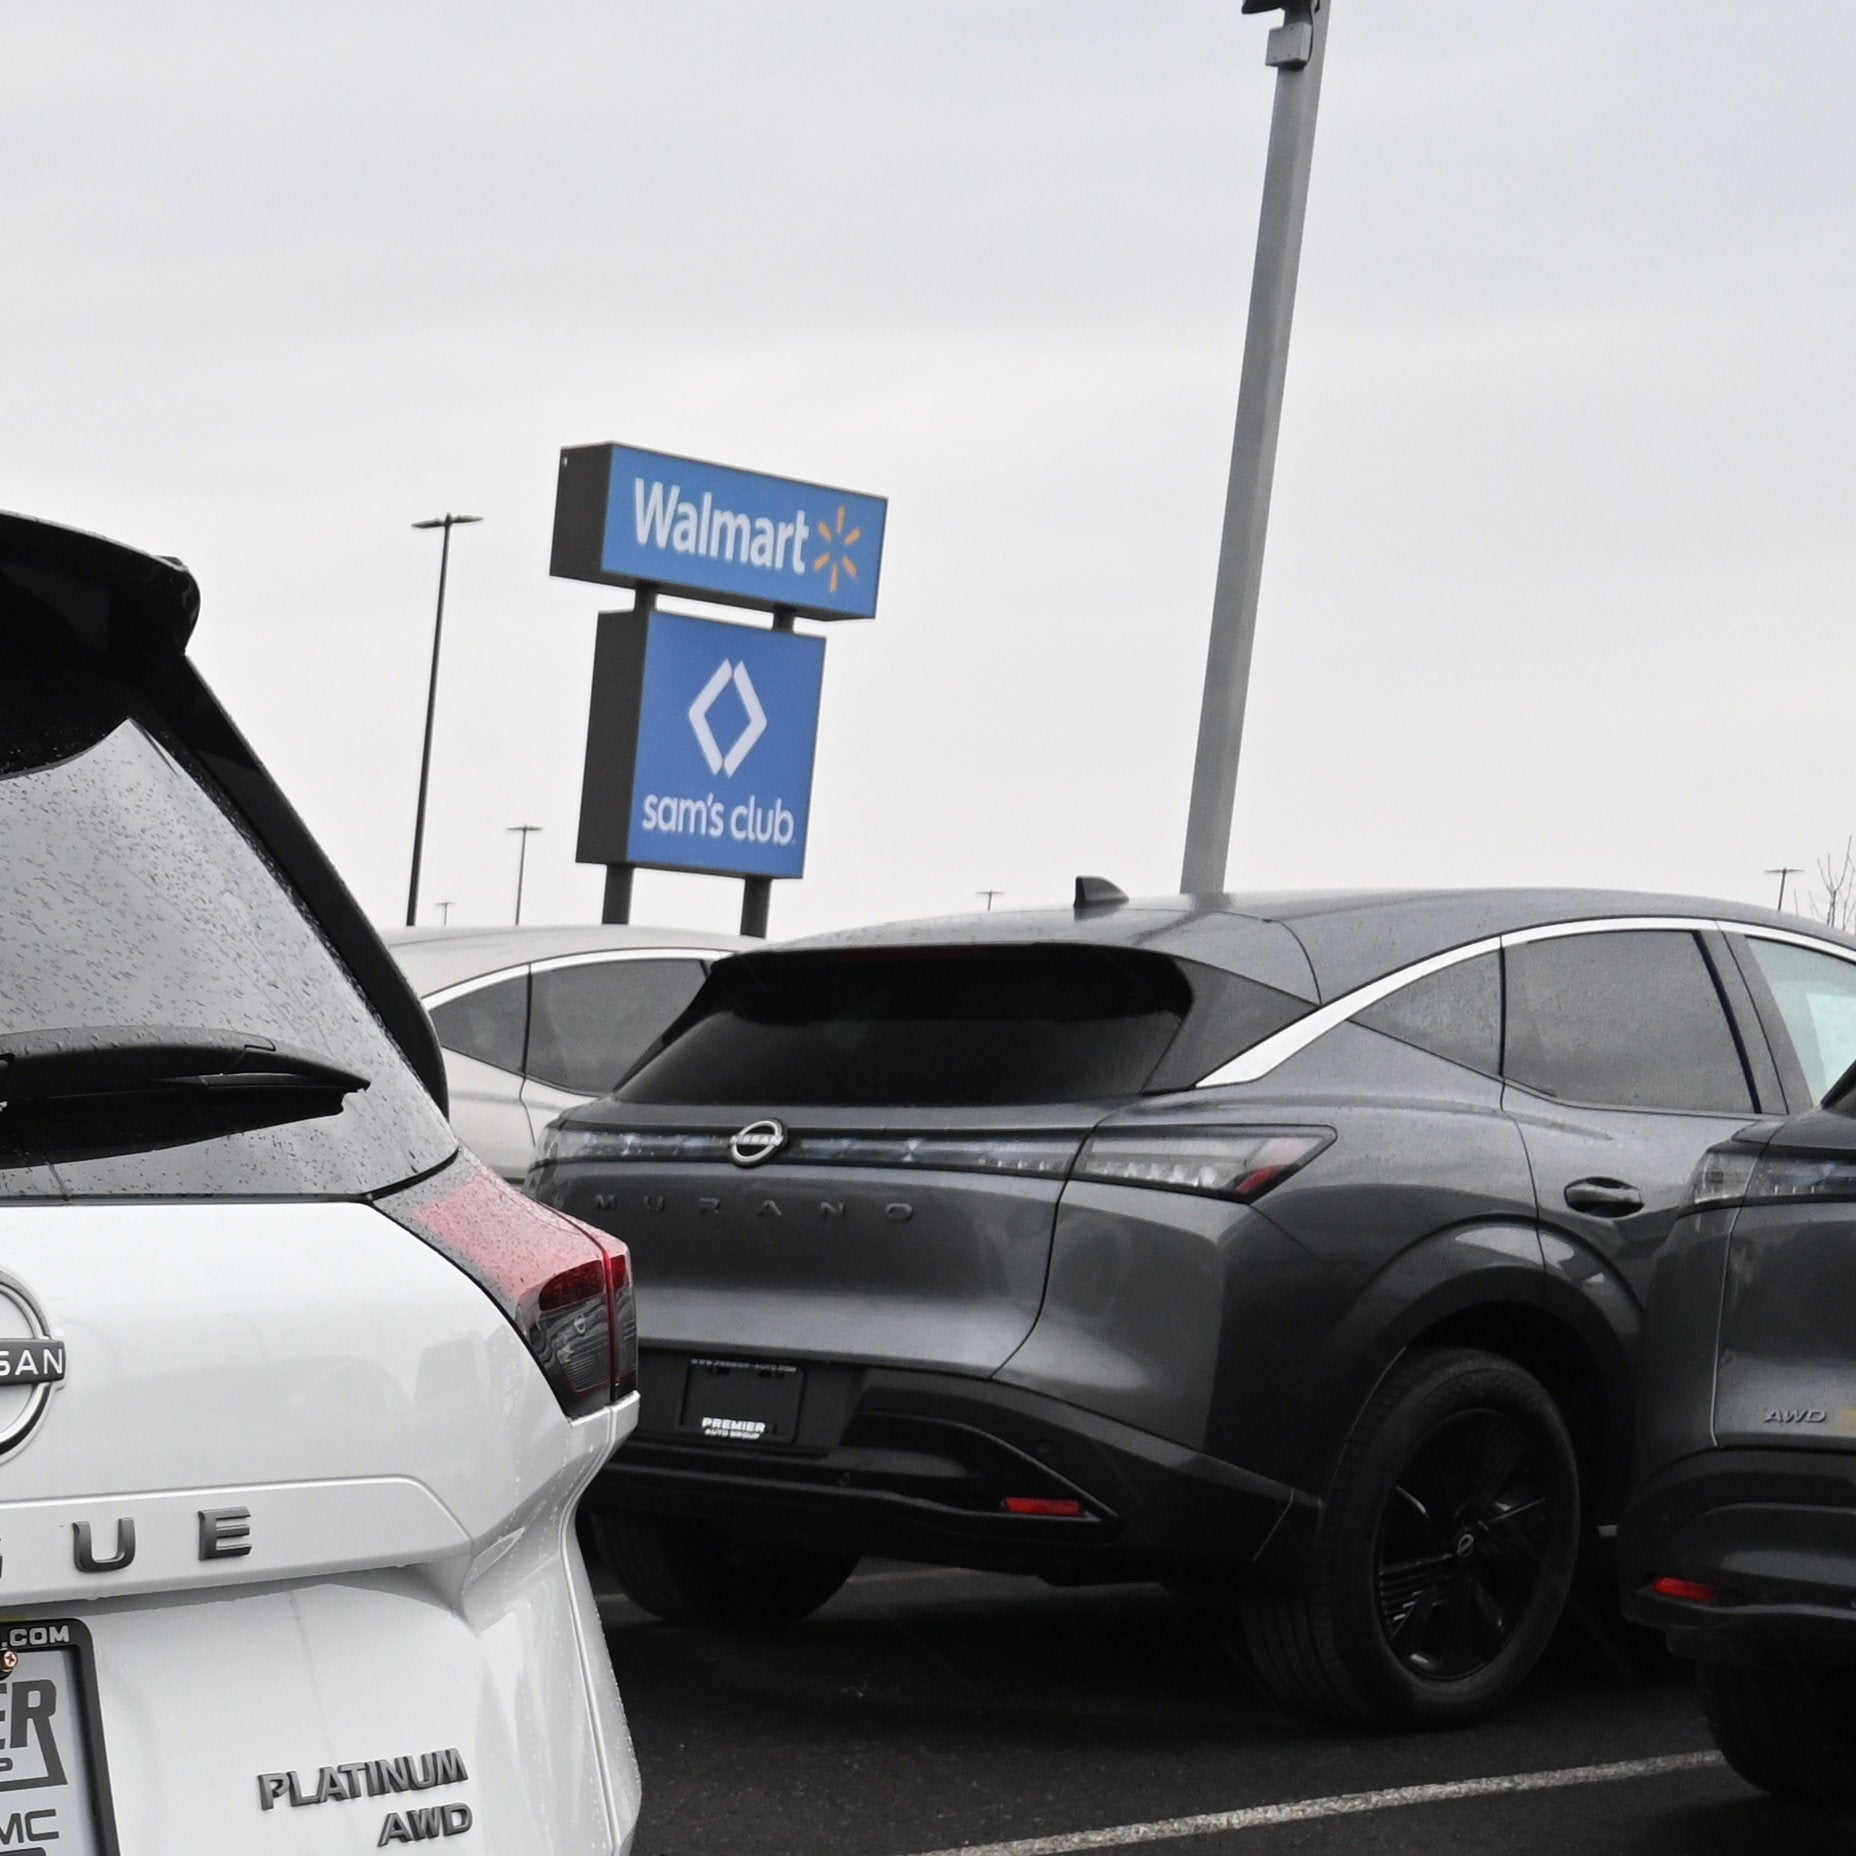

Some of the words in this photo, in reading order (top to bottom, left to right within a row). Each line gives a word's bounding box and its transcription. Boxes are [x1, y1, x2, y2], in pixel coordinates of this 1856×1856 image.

[634, 477, 810, 575] Walmart
[642, 792, 724, 836] sam's
[731, 796, 795, 845] club
[594, 1194, 915, 1221] MURANO
[701, 1416, 766, 1434] PREMIER
[1764, 1409, 1828, 1424] AWD
[257, 1747, 469, 1811] PLATINUM
[377, 1802, 473, 1848] AWD
